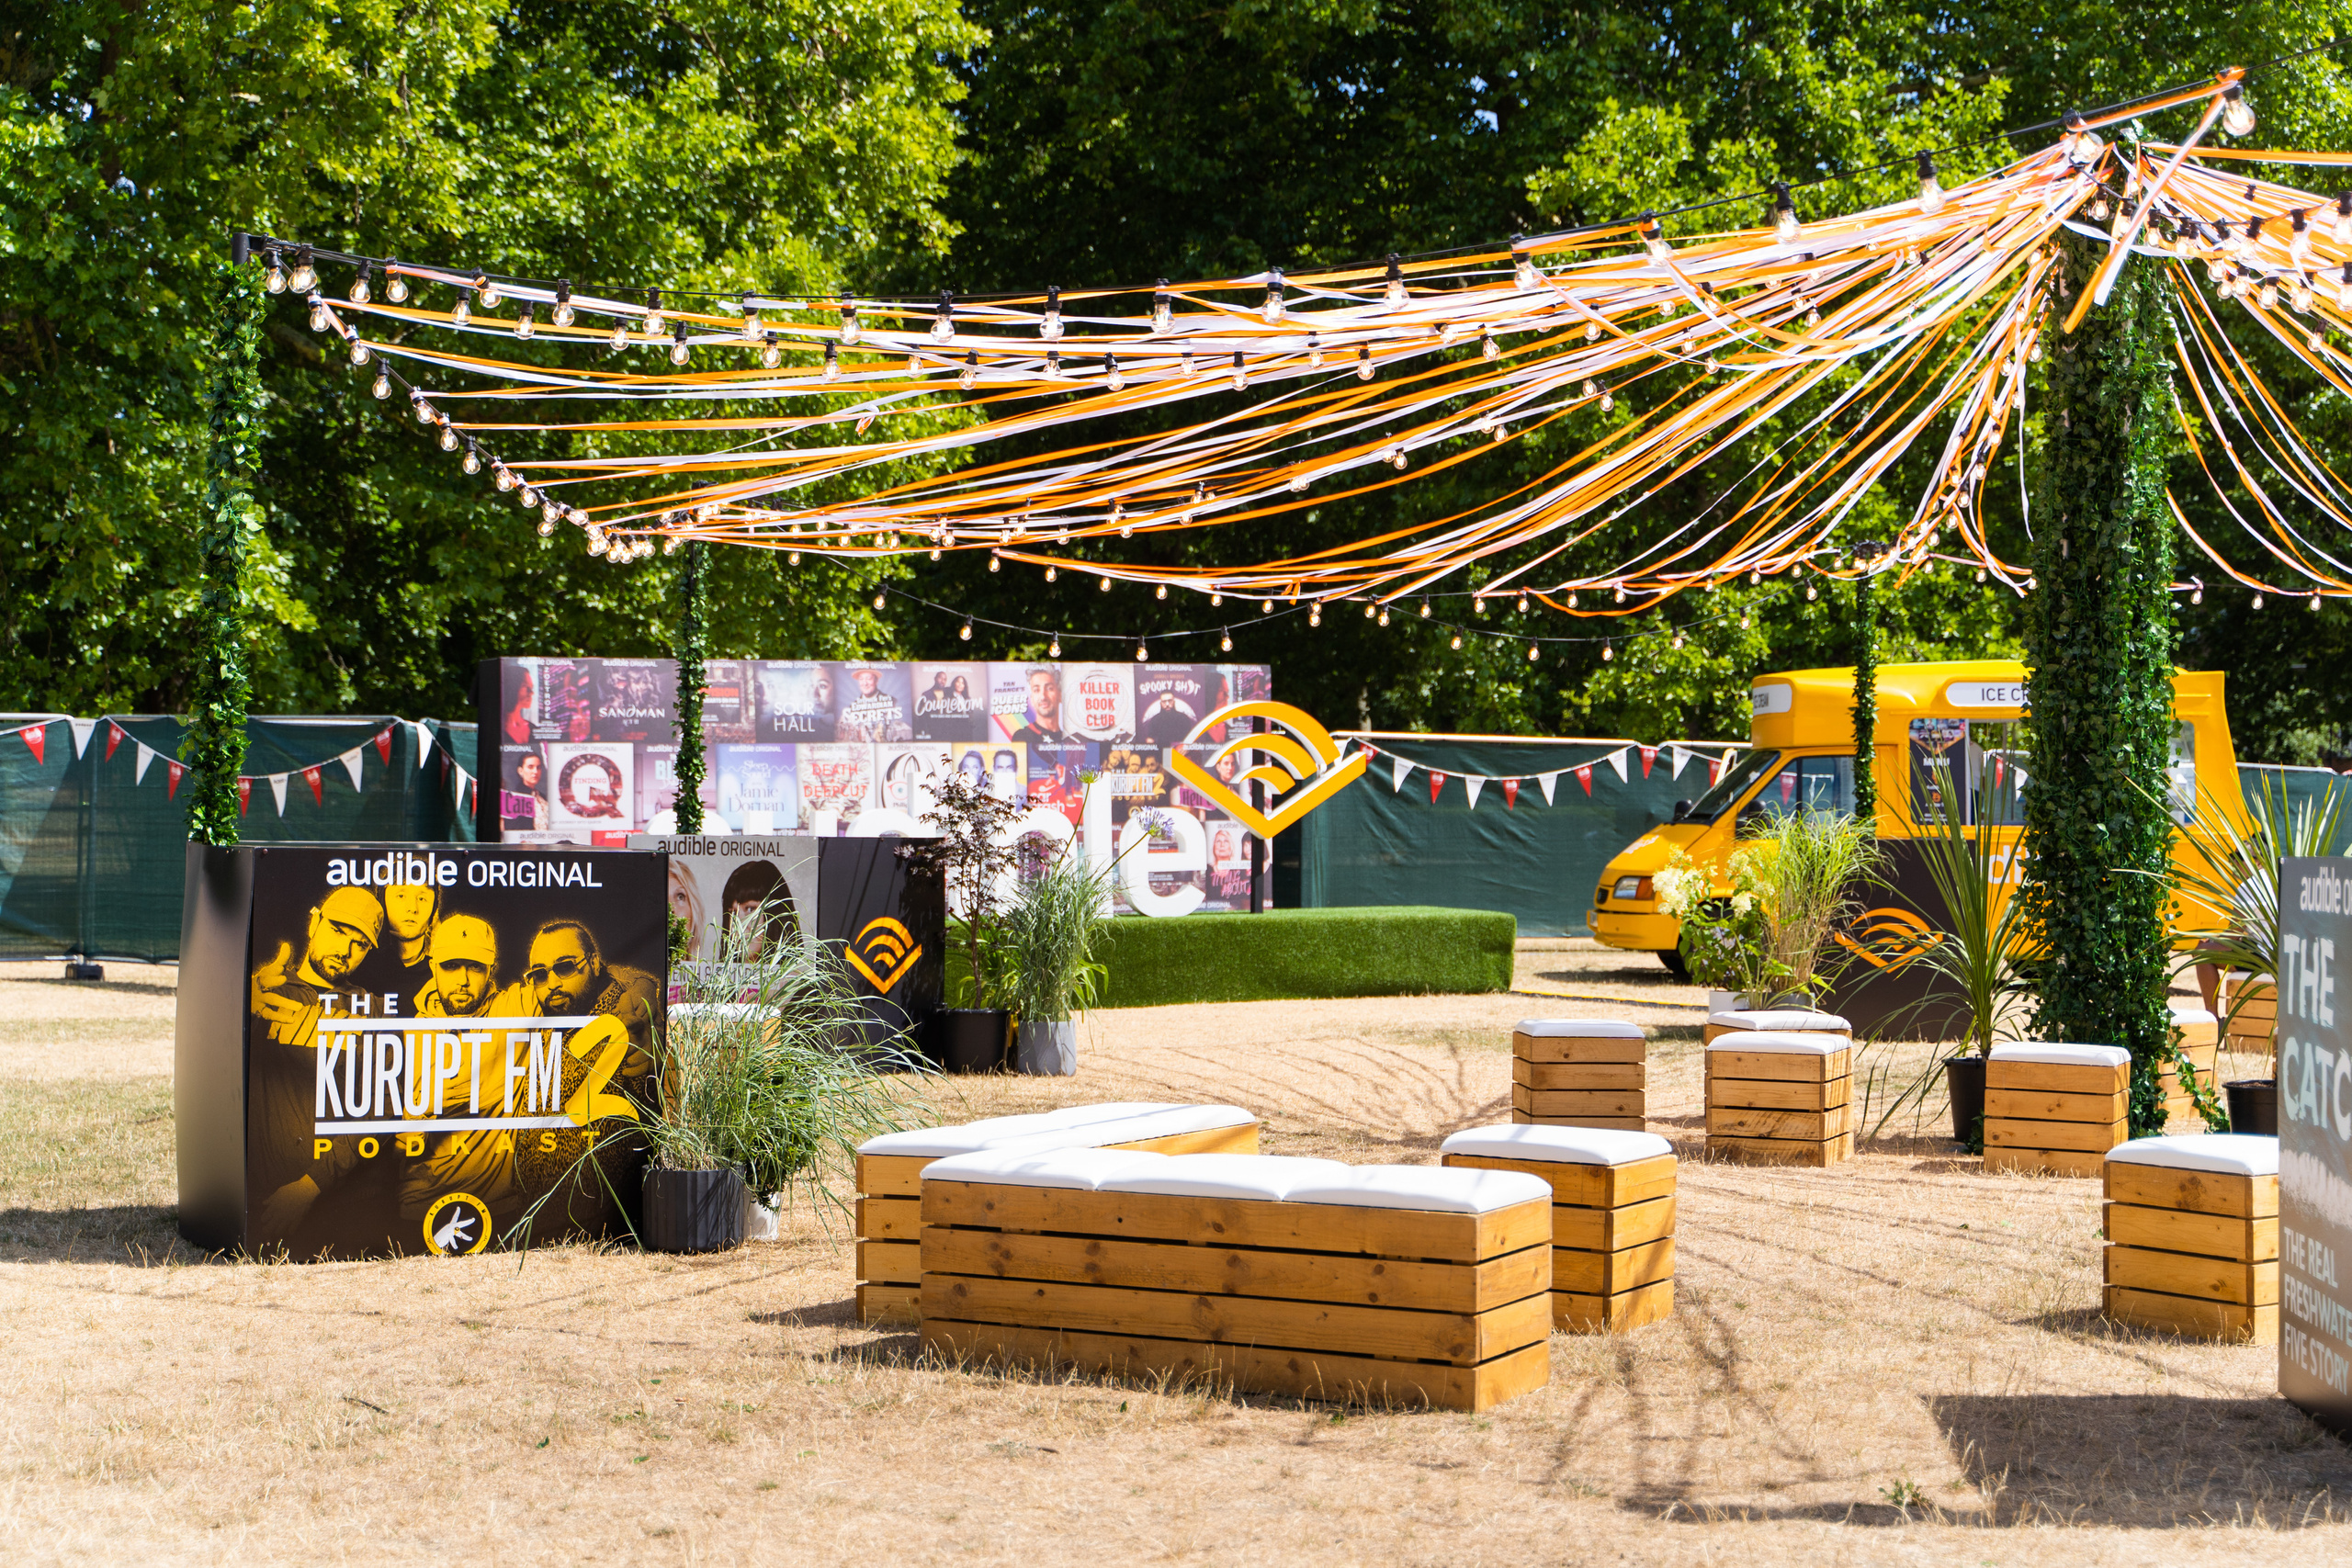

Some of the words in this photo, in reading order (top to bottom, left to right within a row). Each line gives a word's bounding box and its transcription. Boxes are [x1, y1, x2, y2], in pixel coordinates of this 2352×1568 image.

[602, 658, 629, 667] audible
[766, 660, 794, 669] audible
[1145, 663, 1169, 671] audible
[1080, 682, 1120, 694] KILLER
[1139, 680, 1173, 696] SPOOKY
[1981, 687, 2006, 702] ICE
[991, 694, 1028, 705] QUEER
[1085, 698, 1115, 711] BOOK
[598, 705, 665, 718] SANDMAN
[774, 702, 815, 716] SOUR
[842, 706, 903, 725] SECRETS
[990, 704, 1028, 716] ICONS
[774, 716, 816, 732] HALL
[1086, 714, 1115, 728] CLUB
[562, 743, 589, 752] audible
[646, 744, 673, 752] audible
[729, 743, 755, 752] audible
[1038, 742, 1062, 751] audible
[1111, 742, 1135, 751] audible
[1182, 742, 1205, 750] audible
[811, 762, 858, 778] DEATH
[735, 783, 779, 798] Jamie
[803, 783, 868, 798] DEEPCUT
[1111, 776, 1141, 794] KURUPT
[1142, 776, 1154, 793] FM
[1153, 773, 1166, 795] 2
[729, 796, 785, 813] Dornan
[519, 832, 547, 840] audible
[548, 832, 576, 840] ORIGINAL
[658, 837, 717, 856] audible
[720, 840, 786, 857] ORIGINAL
[325, 852, 458, 886] audible
[468, 861, 603, 887] ORIGINAL
[2300, 866, 2342, 915] audible
[2283, 933, 2335, 1029] THE
[318, 993, 399, 1015] THE
[315, 1032, 492, 1118] KURUPT
[503, 1032, 562, 1113] FM
[565, 1013, 639, 1127] 2
[313, 1131, 601, 1159] PODKAST
[429, 1194, 469, 1216] KURUPT
[2283, 1225, 2306, 1271] THE
[2307, 1237, 2339, 1289] REAL
[2283, 1321, 2308, 1371] FIVE
[2309, 1337, 2350, 1397] STORY
